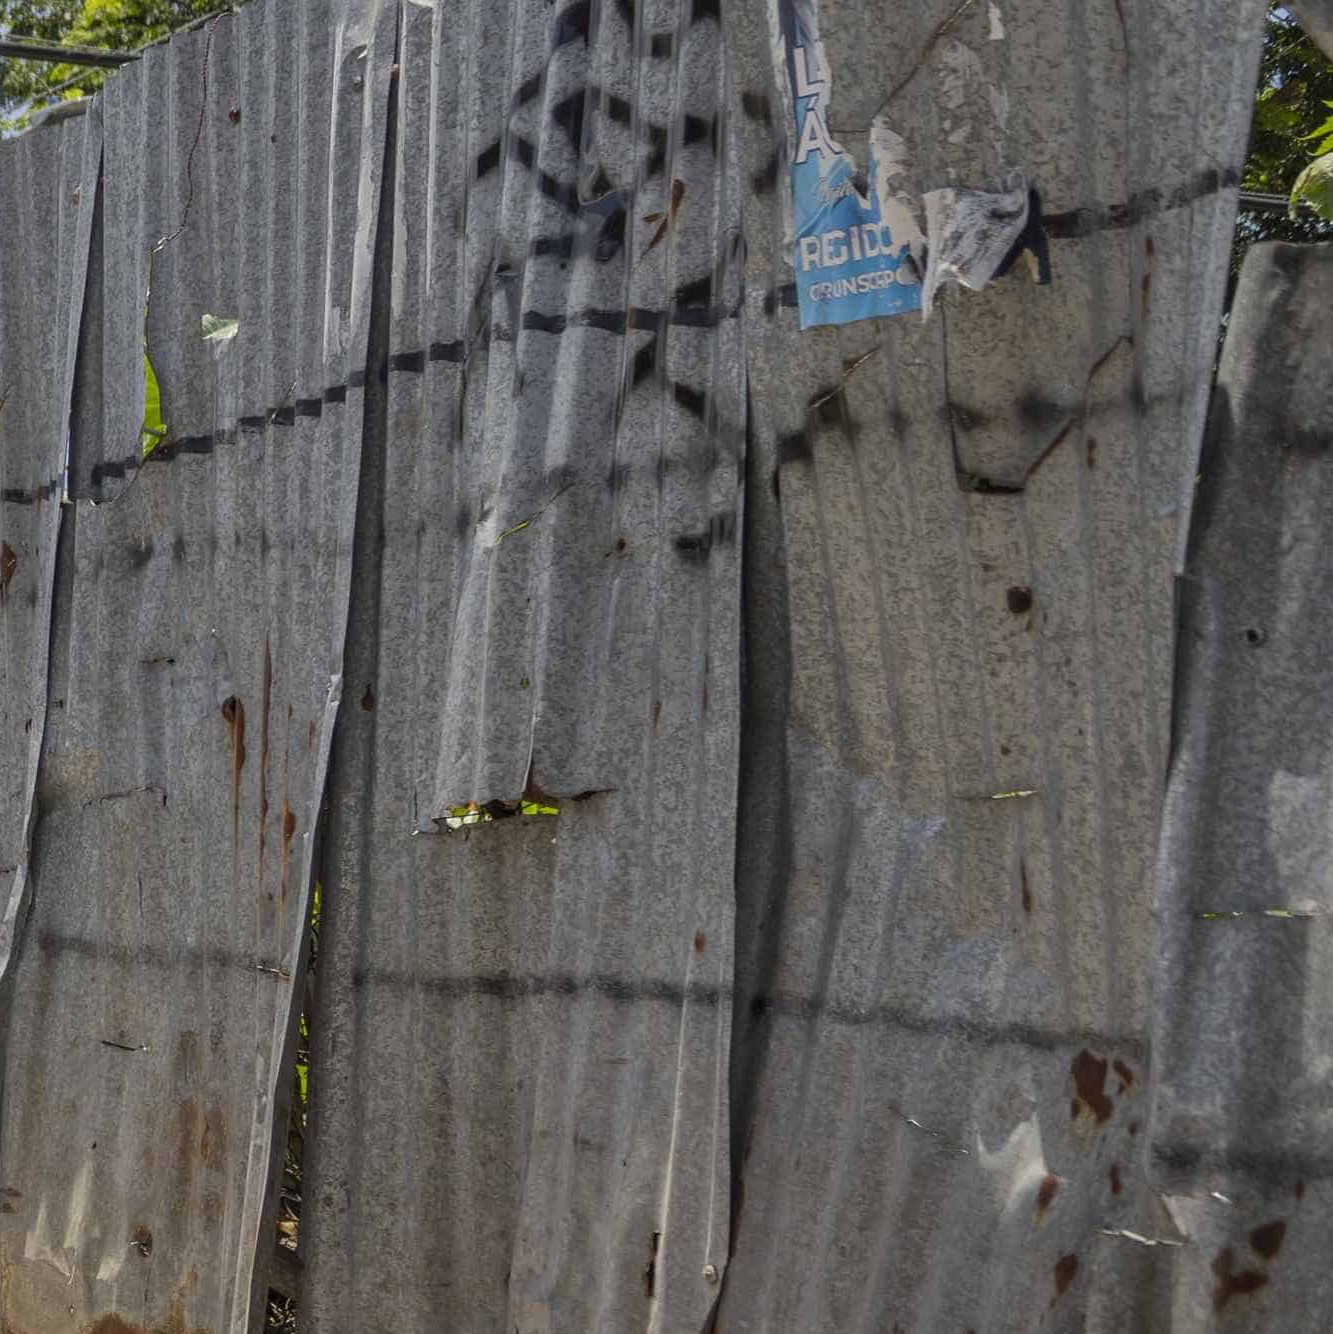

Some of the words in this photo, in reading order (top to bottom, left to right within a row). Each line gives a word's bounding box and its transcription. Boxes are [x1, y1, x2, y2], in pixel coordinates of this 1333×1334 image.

[793, 47, 825, 98] L
[795, 95, 844, 164] Á
[800, 222, 894, 273] REGIDO
